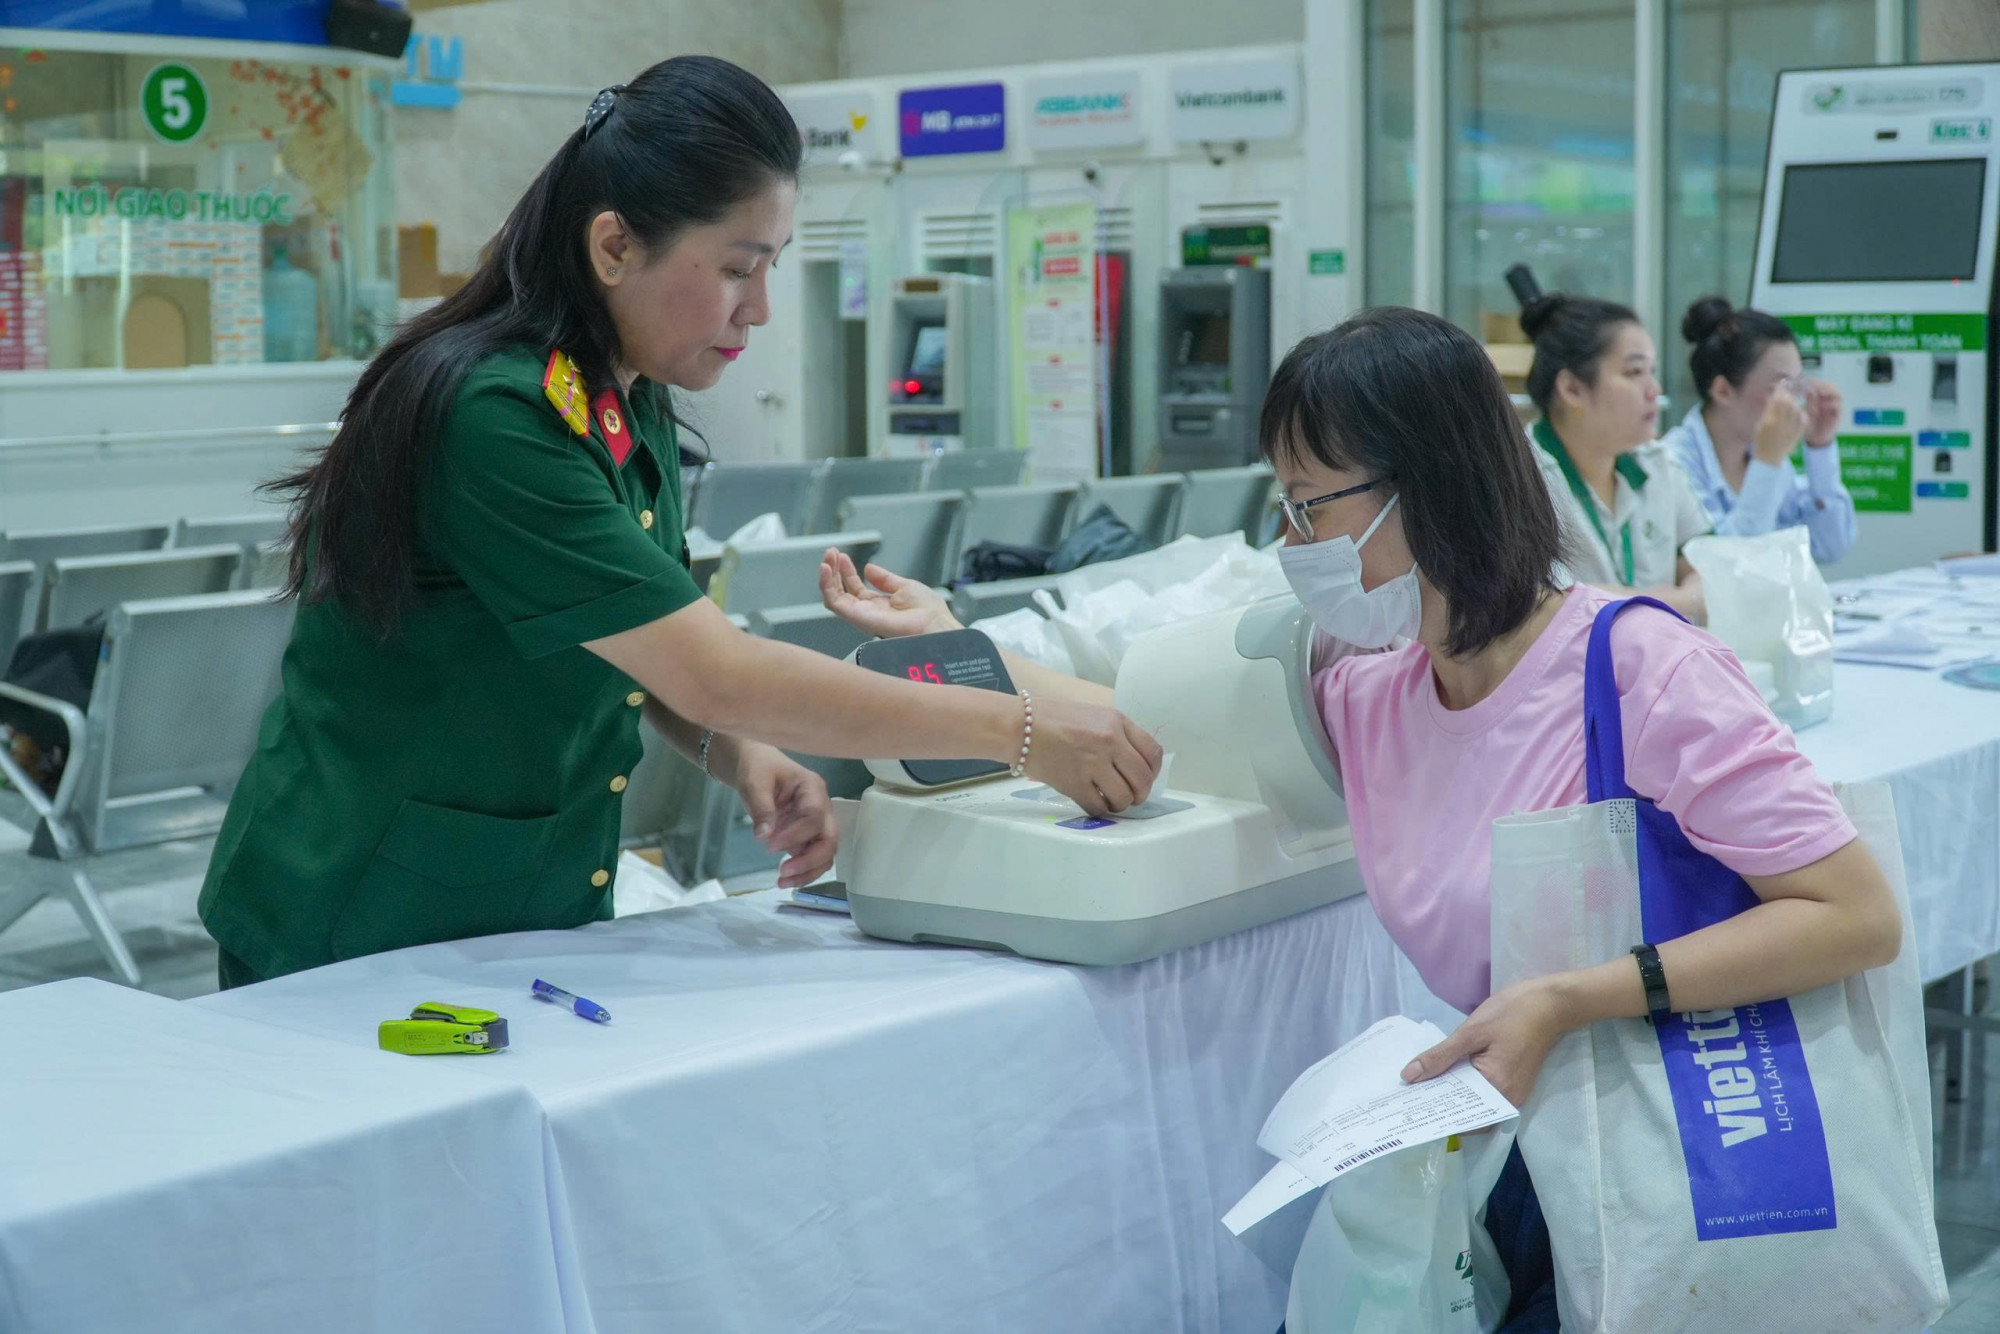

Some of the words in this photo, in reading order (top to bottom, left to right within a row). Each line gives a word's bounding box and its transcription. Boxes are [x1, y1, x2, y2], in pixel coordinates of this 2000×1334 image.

[161, 78, 191, 129] 5
[922, 110, 950, 132] MB
[114, 187, 188, 221] GIAO
[195, 182, 294, 226] THUỐC
[1746, 1004, 1763, 1027] CH
[1750, 1030, 1772, 1054] KHÍ
[1682, 1008, 1767, 1148] vietti
[1772, 1094, 1794, 1132] LỊCH
[1705, 1207, 1828, 1226] www.viettien.com.vn
